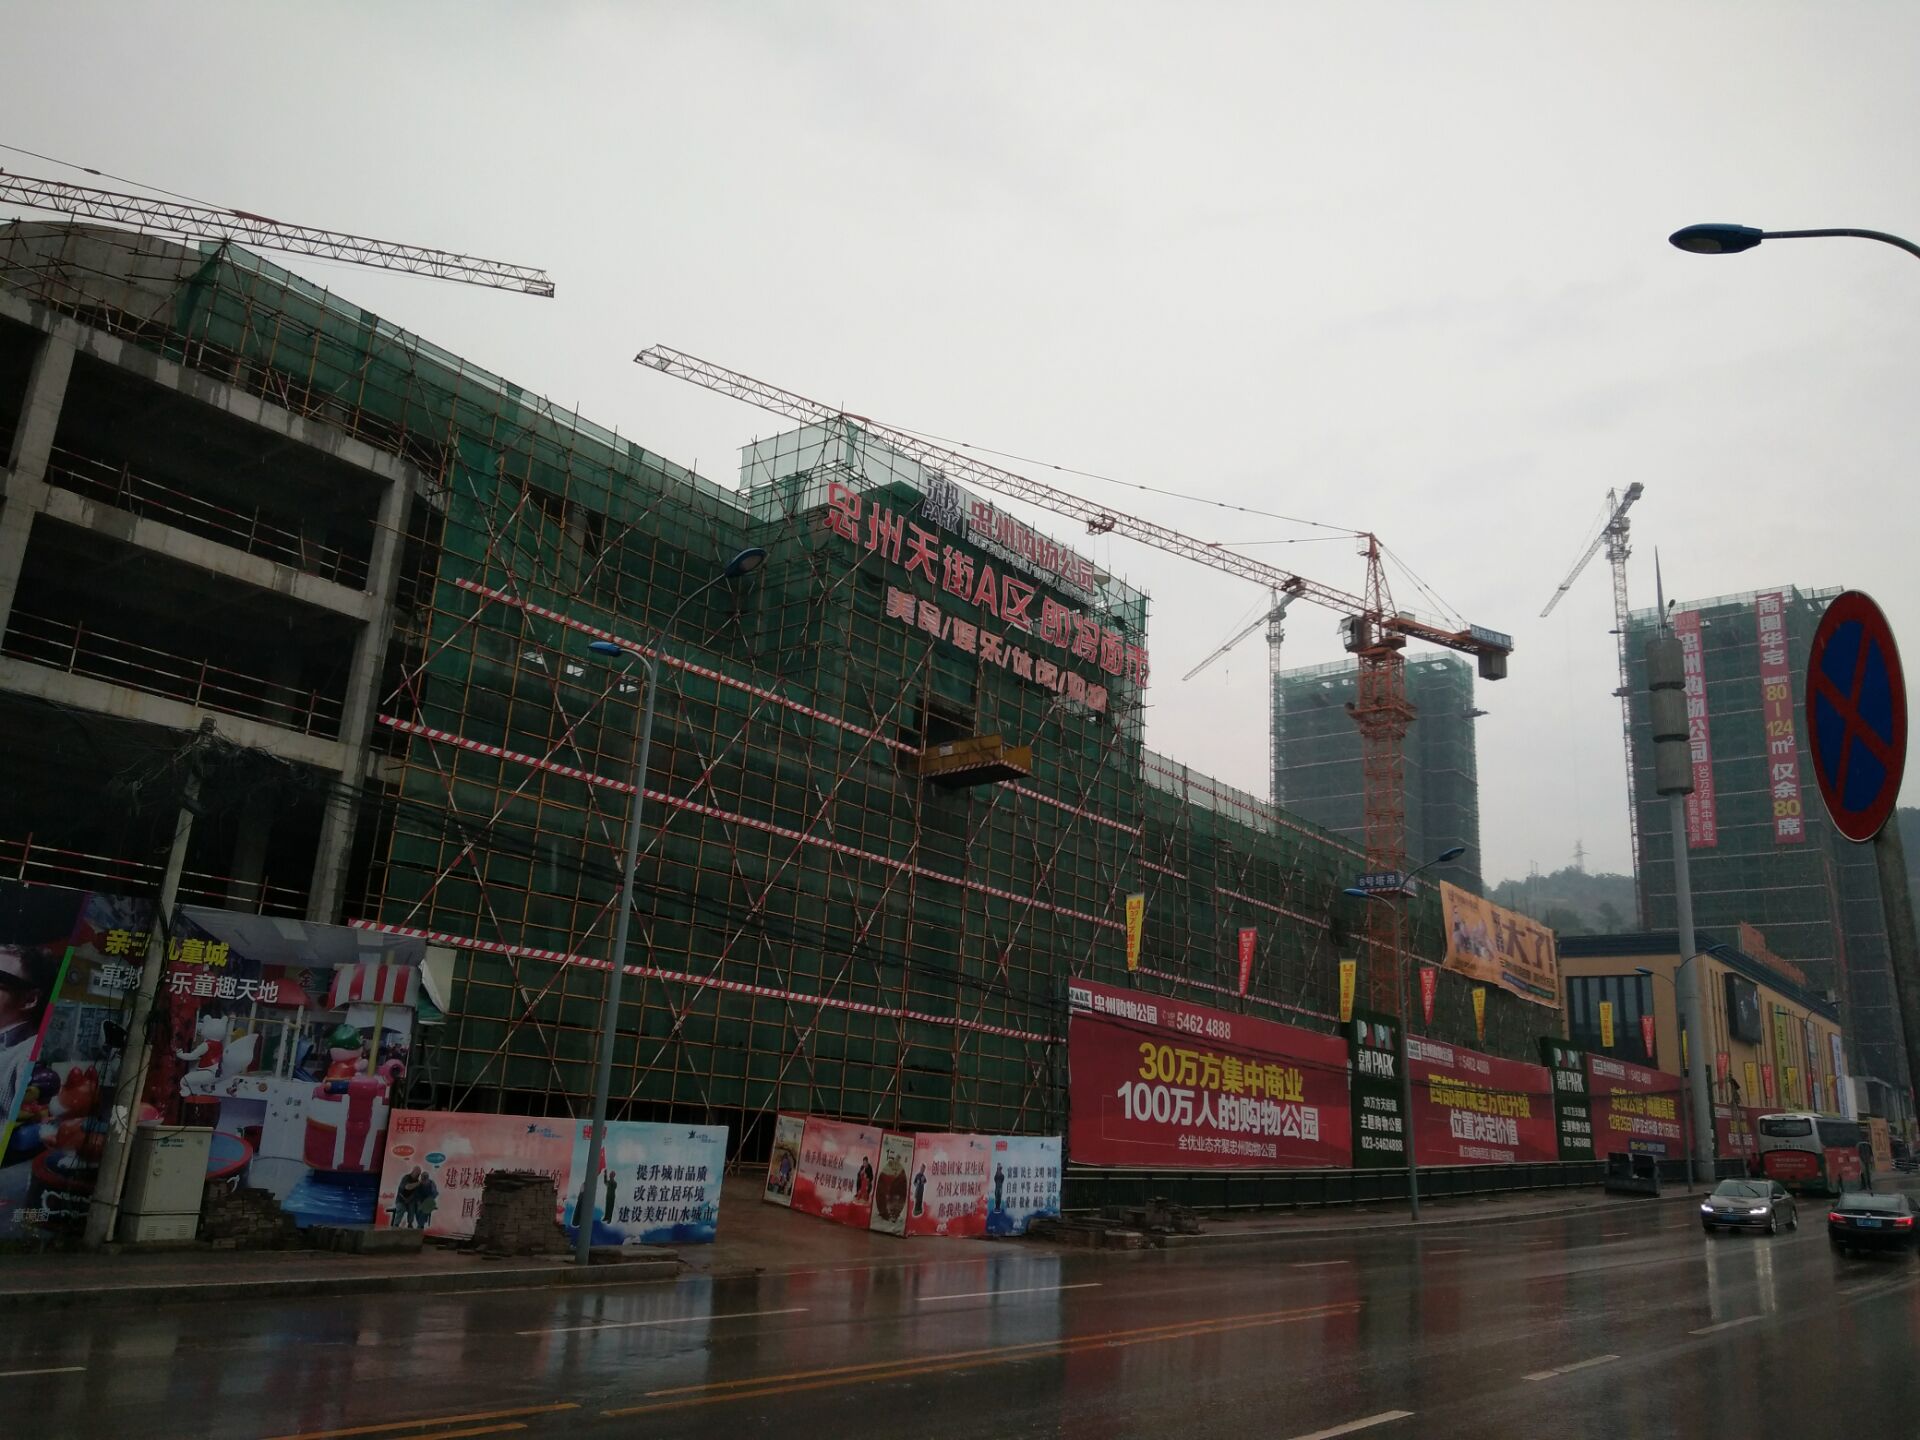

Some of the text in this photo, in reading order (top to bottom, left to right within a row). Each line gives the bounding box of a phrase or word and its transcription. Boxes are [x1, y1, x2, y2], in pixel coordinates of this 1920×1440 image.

[921, 501, 962, 535] PARK
[823, 481, 1039, 634] 忠州天街A区
[969, 500, 1095, 596] 忠州购物公园
[99, 962, 280, 1004] 寓教乐童趣天地
[1094, 993, 1158, 1026] 忠州购物公园
[1176, 1011, 1203, 1034] 5462
[1205, 1018, 1231, 1040] 4888
[1137, 1041, 1305, 1104] 30万方集中商业
[1117, 1080, 1320, 1142] 100万人的购物公园
[1359, 1113, 1403, 1133] 主题购物公园
[1449, 1108, 1520, 1146] 位置决定价值
[636, 1163, 708, 1183] 提升城市品质
[1021, 1166, 1032, 1179] 民主
[1034, 1166, 1045, 1179] 文明
[633, 1184, 705, 1203] 改善宜居环境
[617, 1205, 715, 1224] 建设美好山水城市
